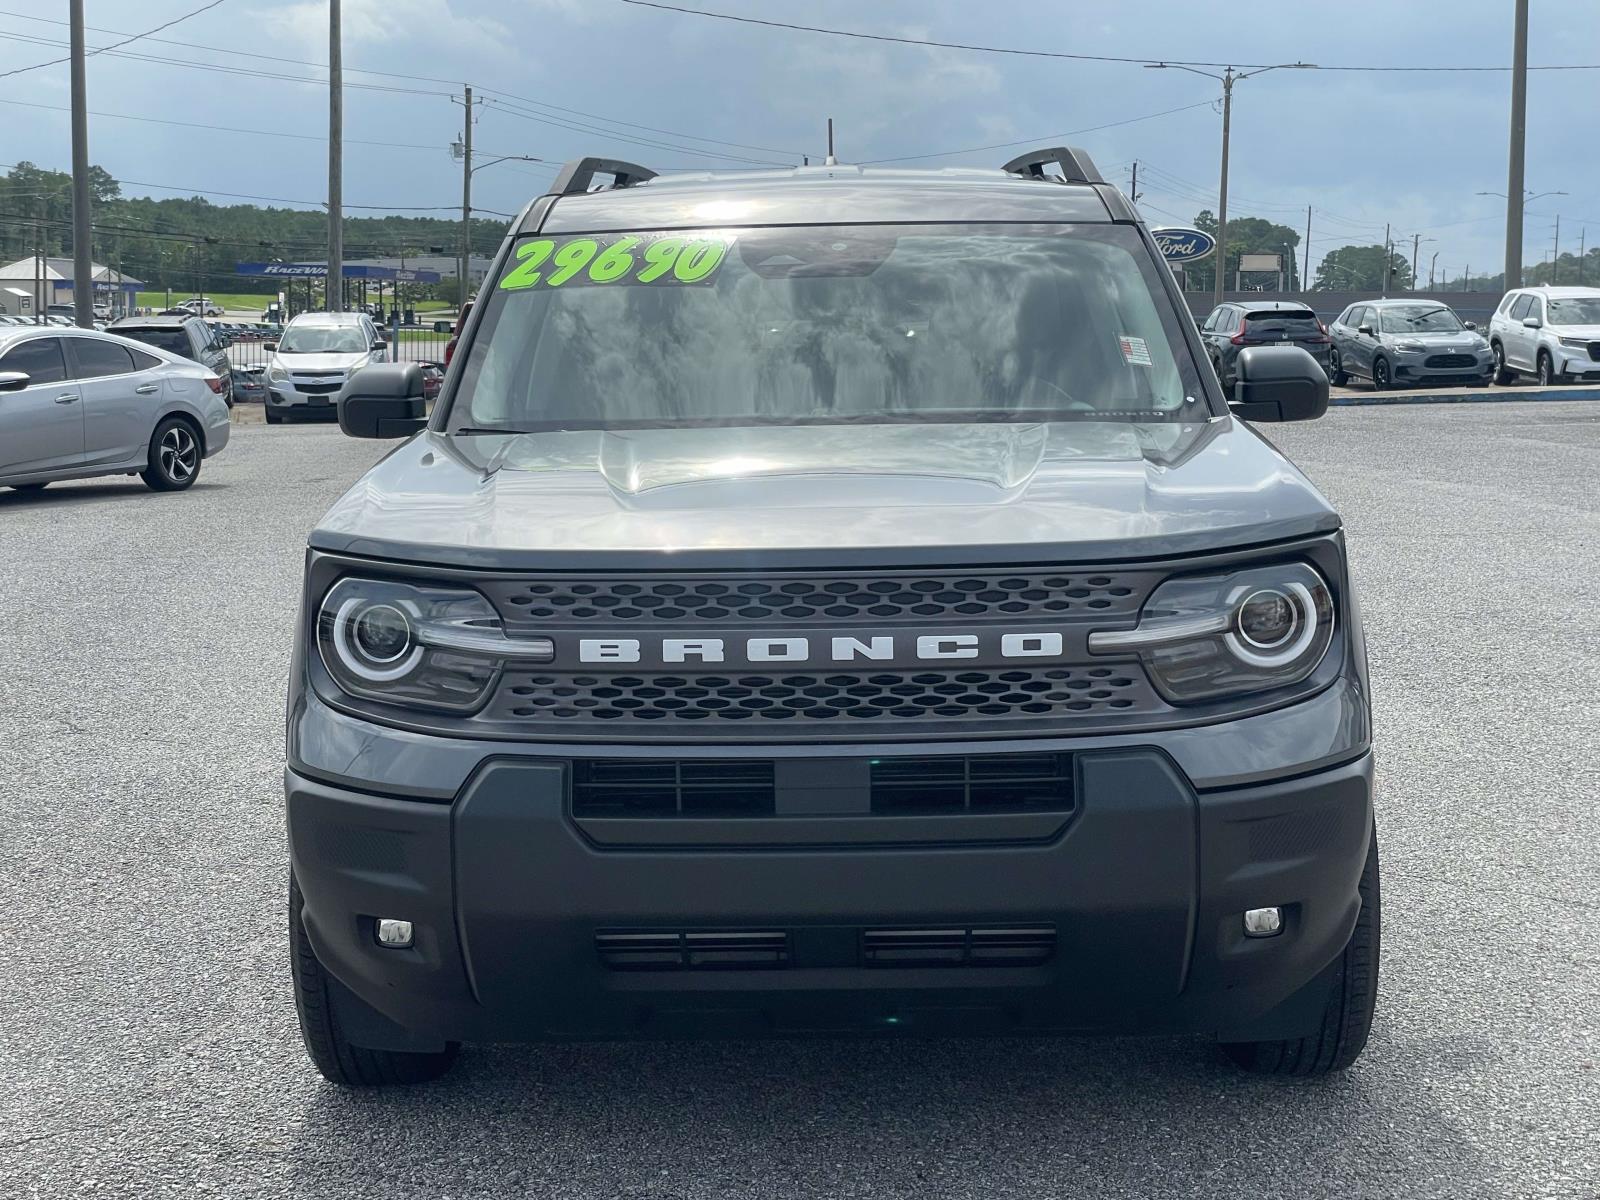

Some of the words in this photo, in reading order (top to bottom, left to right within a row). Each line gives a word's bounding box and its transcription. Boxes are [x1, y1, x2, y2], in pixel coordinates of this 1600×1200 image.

[1154, 235, 1196, 254] Ford
[264, 265, 328, 275] RACEWA
[500, 237, 729, 289] 29690
[579, 632, 1063, 662] BRONCO
